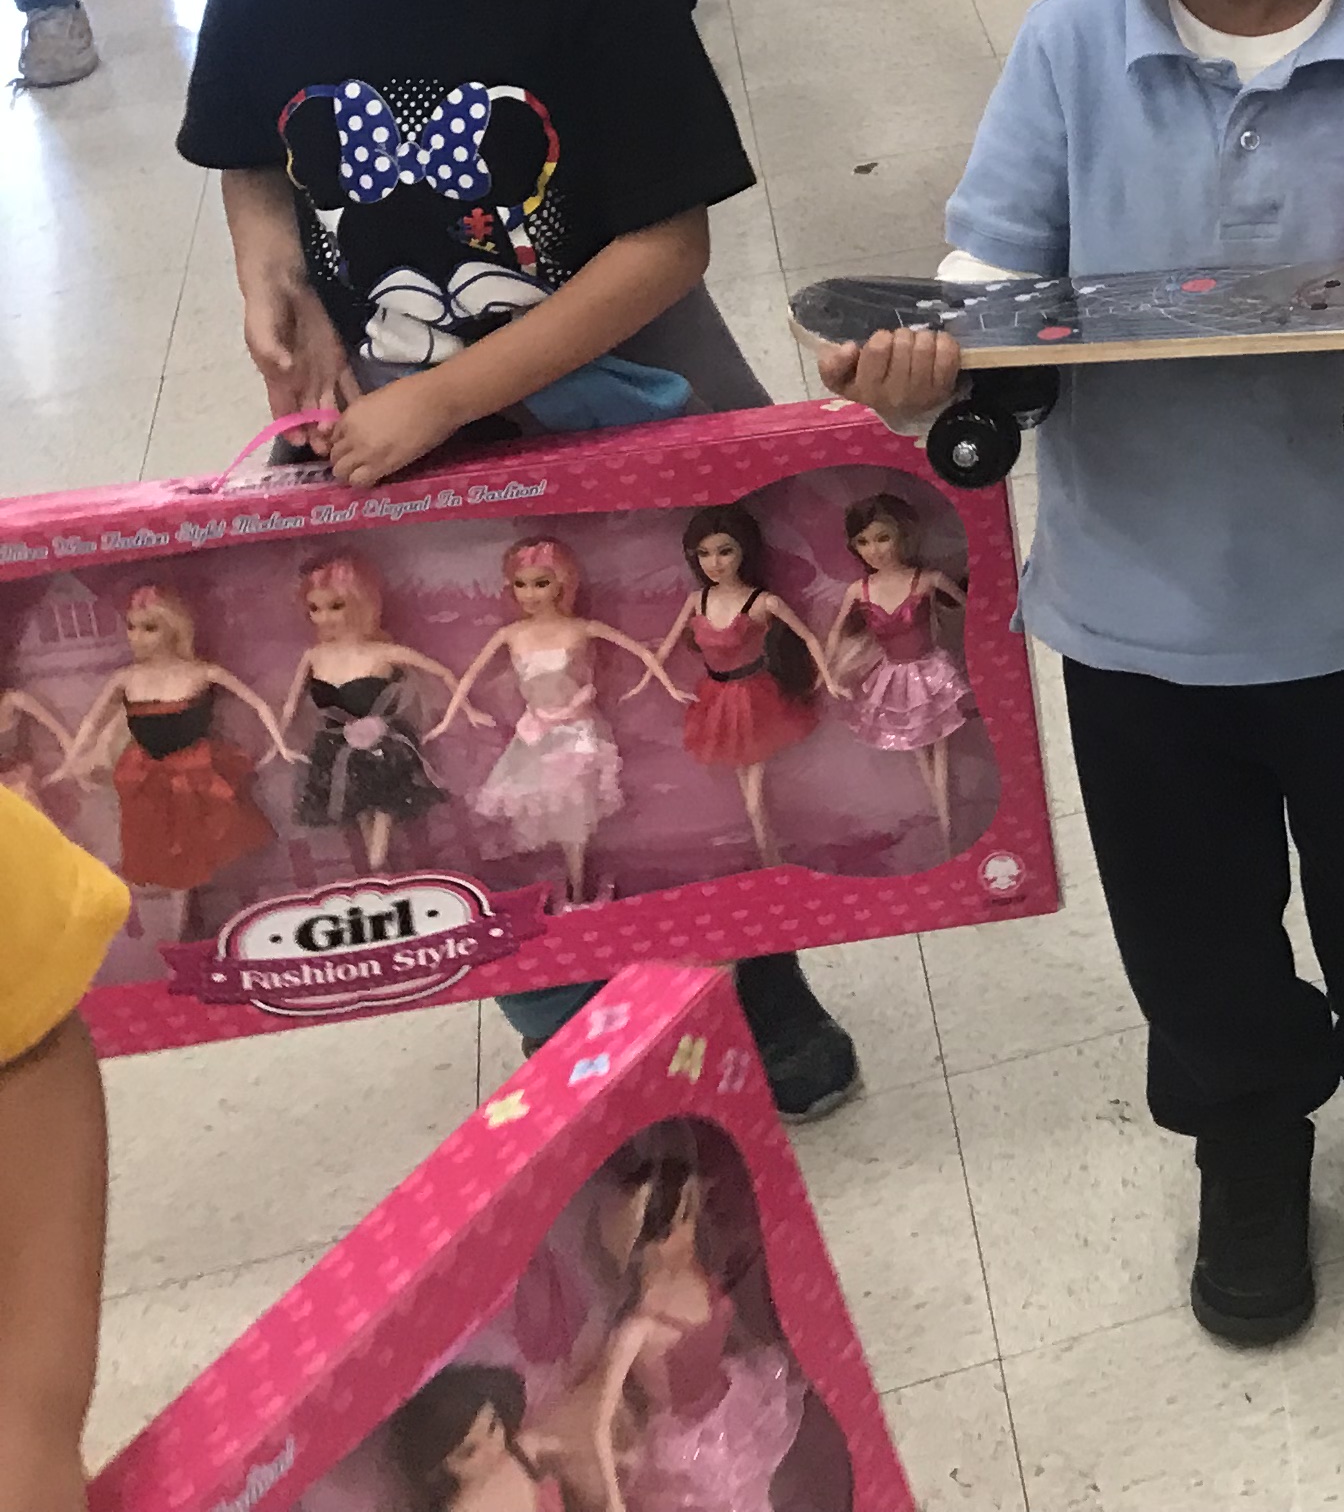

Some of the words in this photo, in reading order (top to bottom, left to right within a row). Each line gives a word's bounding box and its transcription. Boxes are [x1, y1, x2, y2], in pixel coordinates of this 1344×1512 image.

[230, 511, 305, 536] Modern
[311, 501, 357, 526] And
[362, 495, 432, 522] Elegant
[435, 489, 463, 508] In
[467, 479, 547, 505] Fashion!
[296, 898, 417, 952] Girl
[241, 957, 381, 991] Fashion
[392, 937, 479, 972] Style
